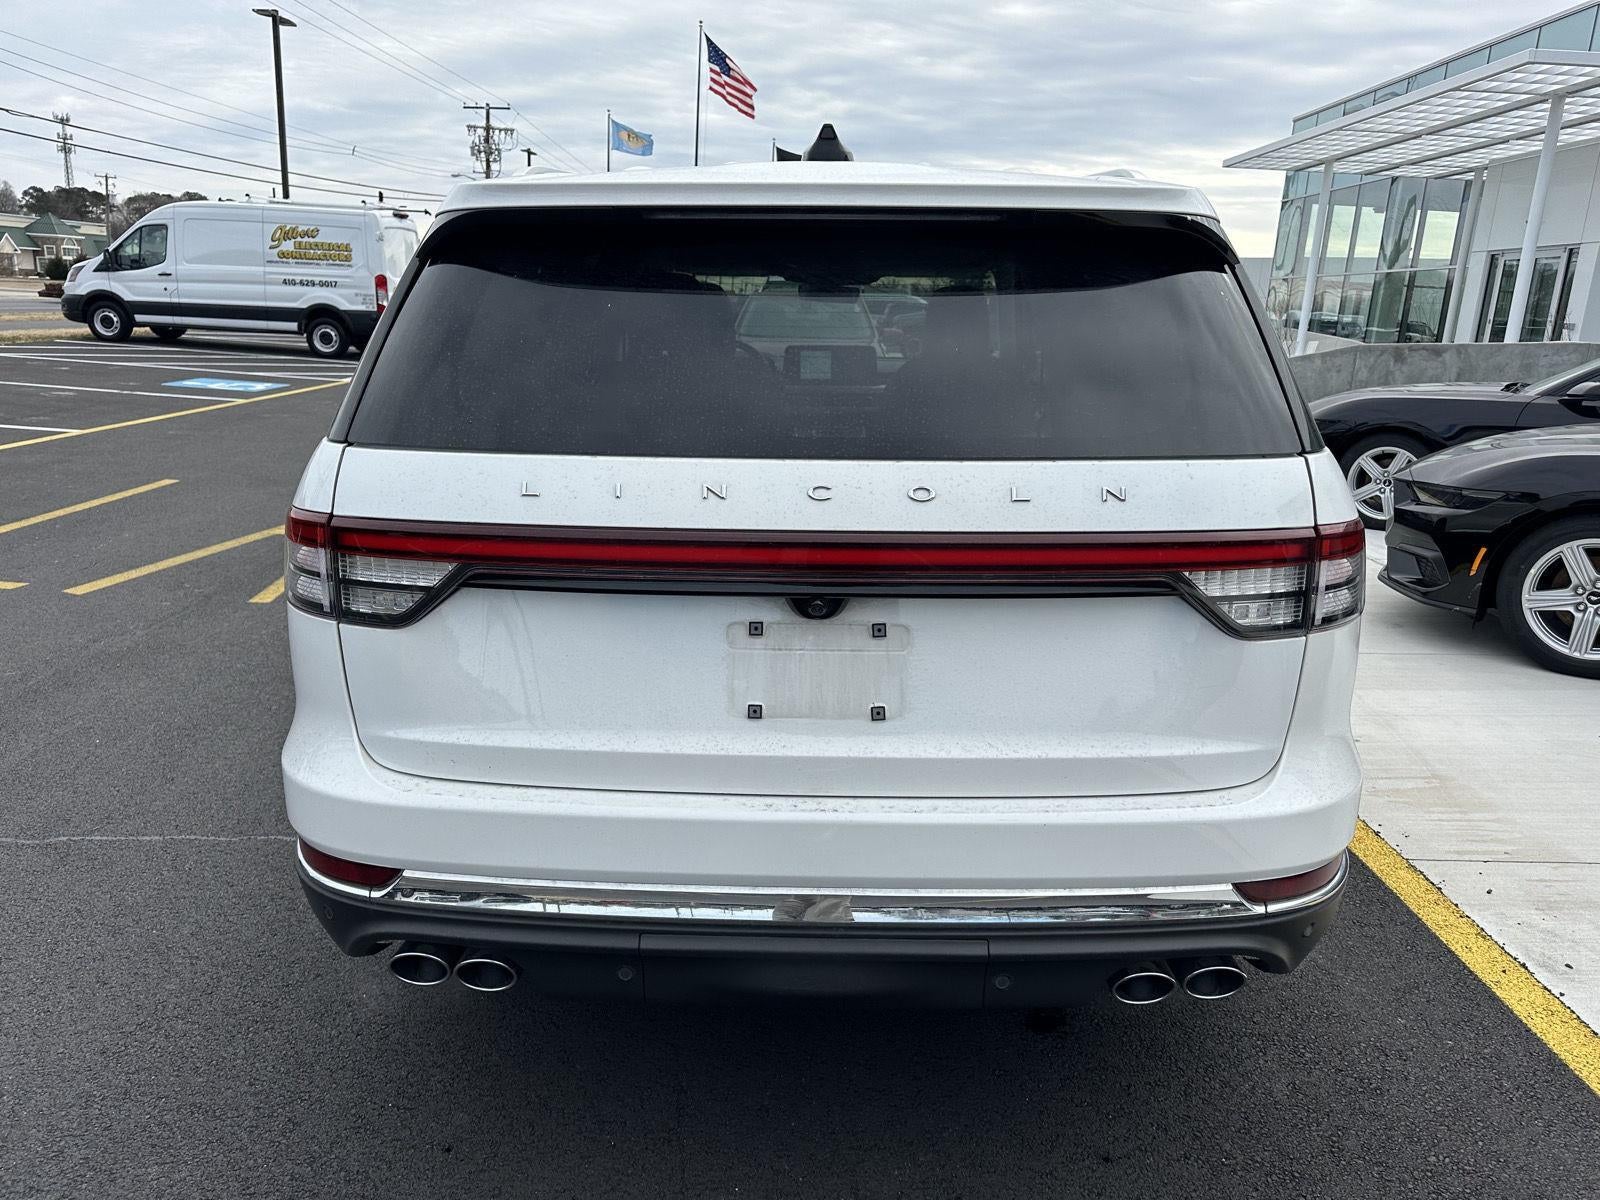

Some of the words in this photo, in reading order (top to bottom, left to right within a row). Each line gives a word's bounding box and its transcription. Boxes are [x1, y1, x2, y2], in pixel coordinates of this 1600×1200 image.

[269, 225, 320, 249] Gilbert
[294, 241, 352, 252] ELECTRICAL
[278, 250, 352, 262] CONTRACTORS
[282, 278, 338, 288] 410-629-0017
[520, 480, 1127, 503] LINCOLN
